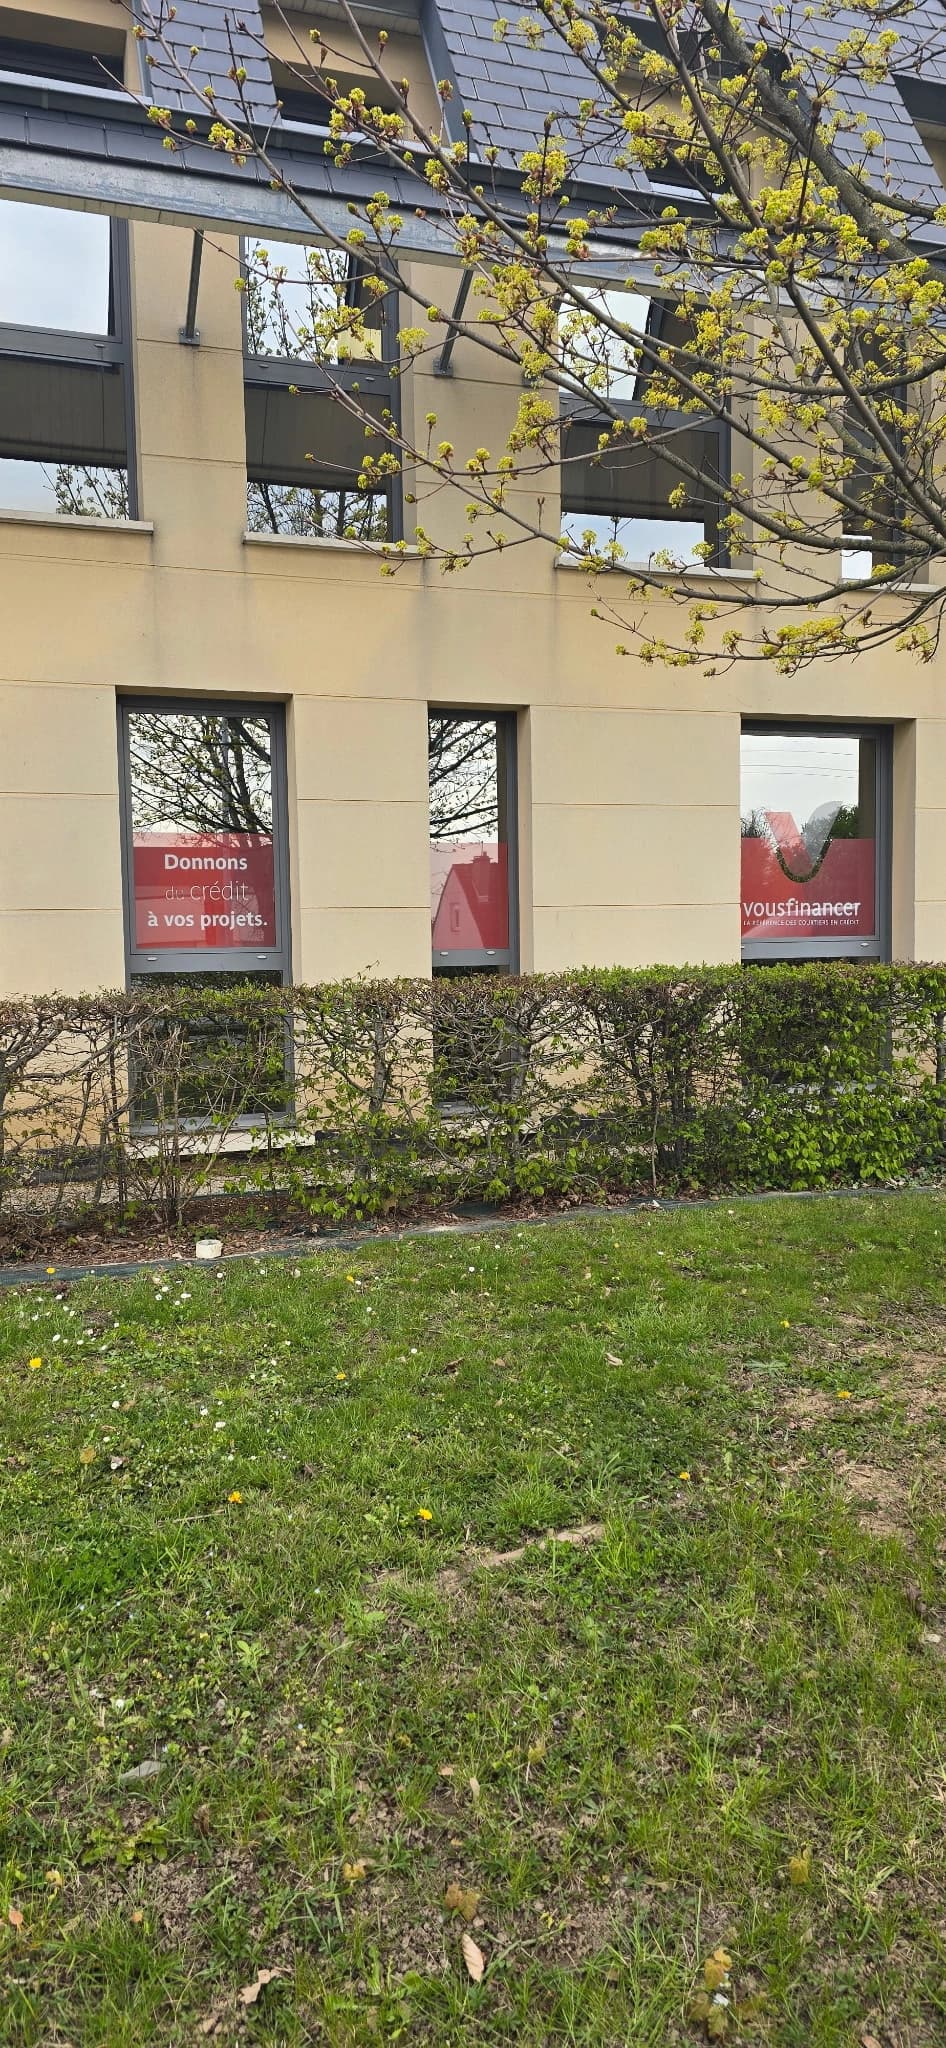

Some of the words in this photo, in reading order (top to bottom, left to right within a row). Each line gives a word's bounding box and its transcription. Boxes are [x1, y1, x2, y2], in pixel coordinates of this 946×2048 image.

[164, 853, 248, 870] Donnons
[165, 885, 186, 901] du
[190, 880, 249, 901] crédit
[743, 898, 861, 917] vousfinancer
[147, 910, 159, 927] à
[164, 913, 195, 927] vos
[200, 910, 268, 931] projets.
